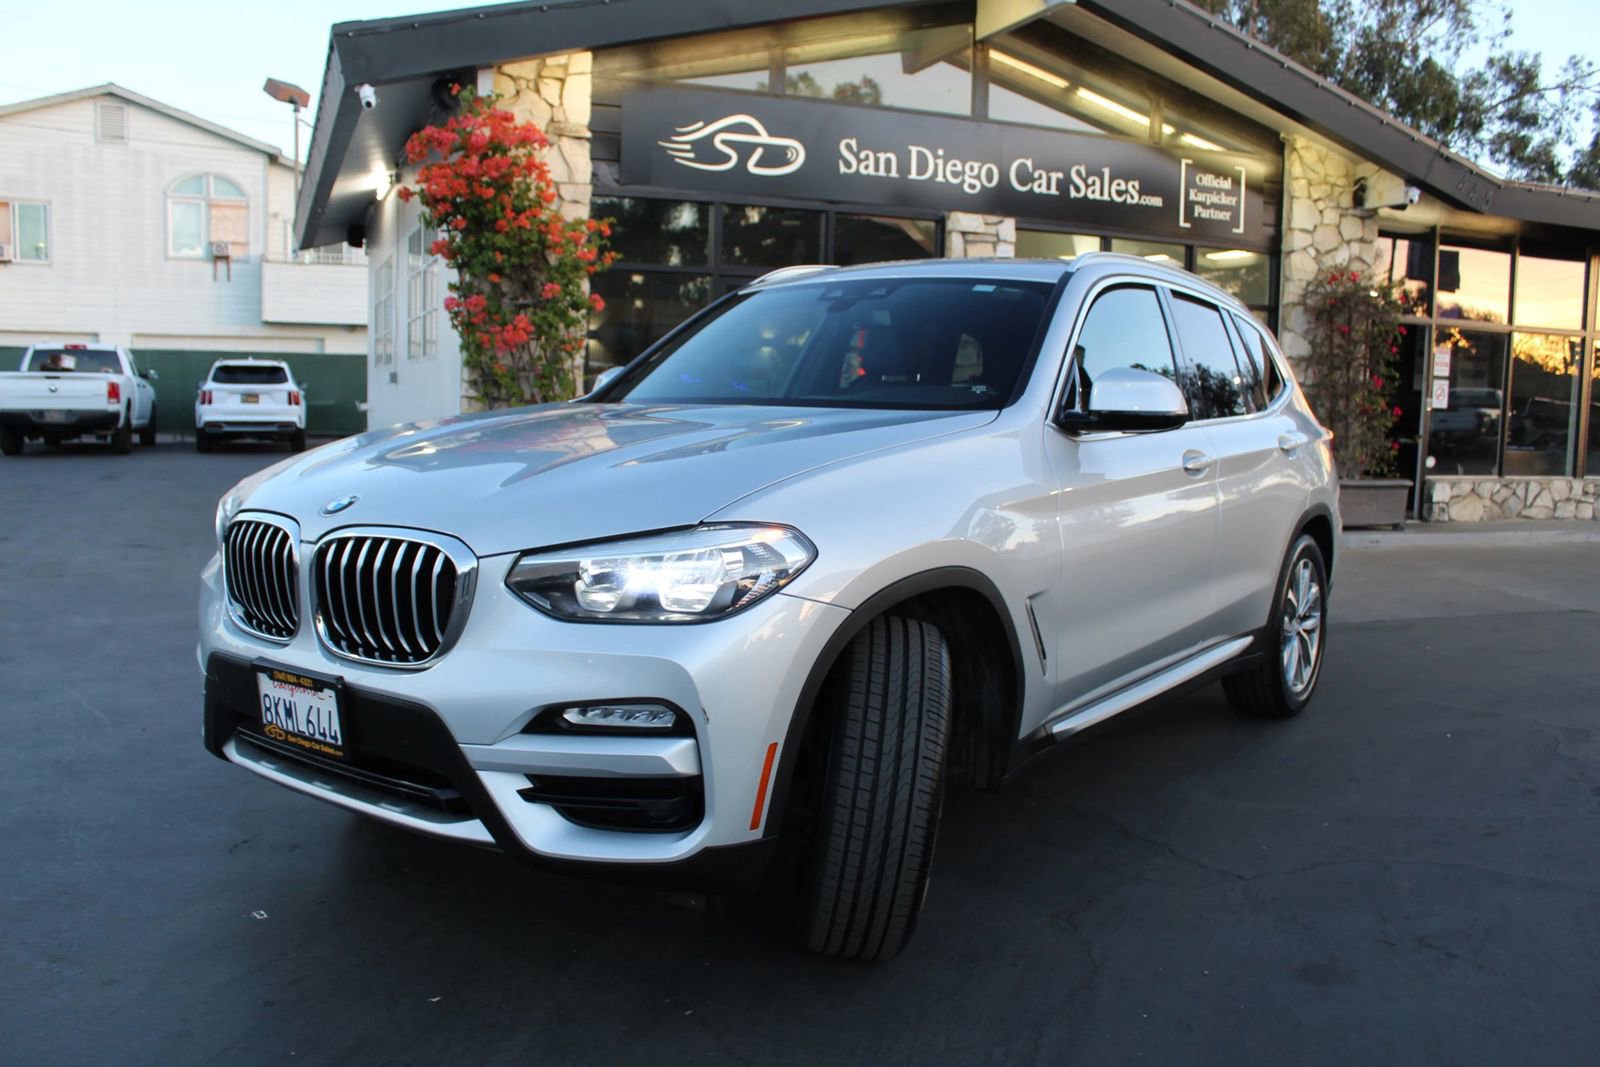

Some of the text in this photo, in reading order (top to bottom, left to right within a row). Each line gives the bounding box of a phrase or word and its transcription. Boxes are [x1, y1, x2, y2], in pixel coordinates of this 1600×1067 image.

[838, 137, 1163, 208] San Diego Car Sales.com
[1195, 173, 1232, 190] Official
[1188, 188, 1238, 206] Karpicker
[1193, 204, 1233, 221] Partner
[262, 692, 339, 745] 8KML644
